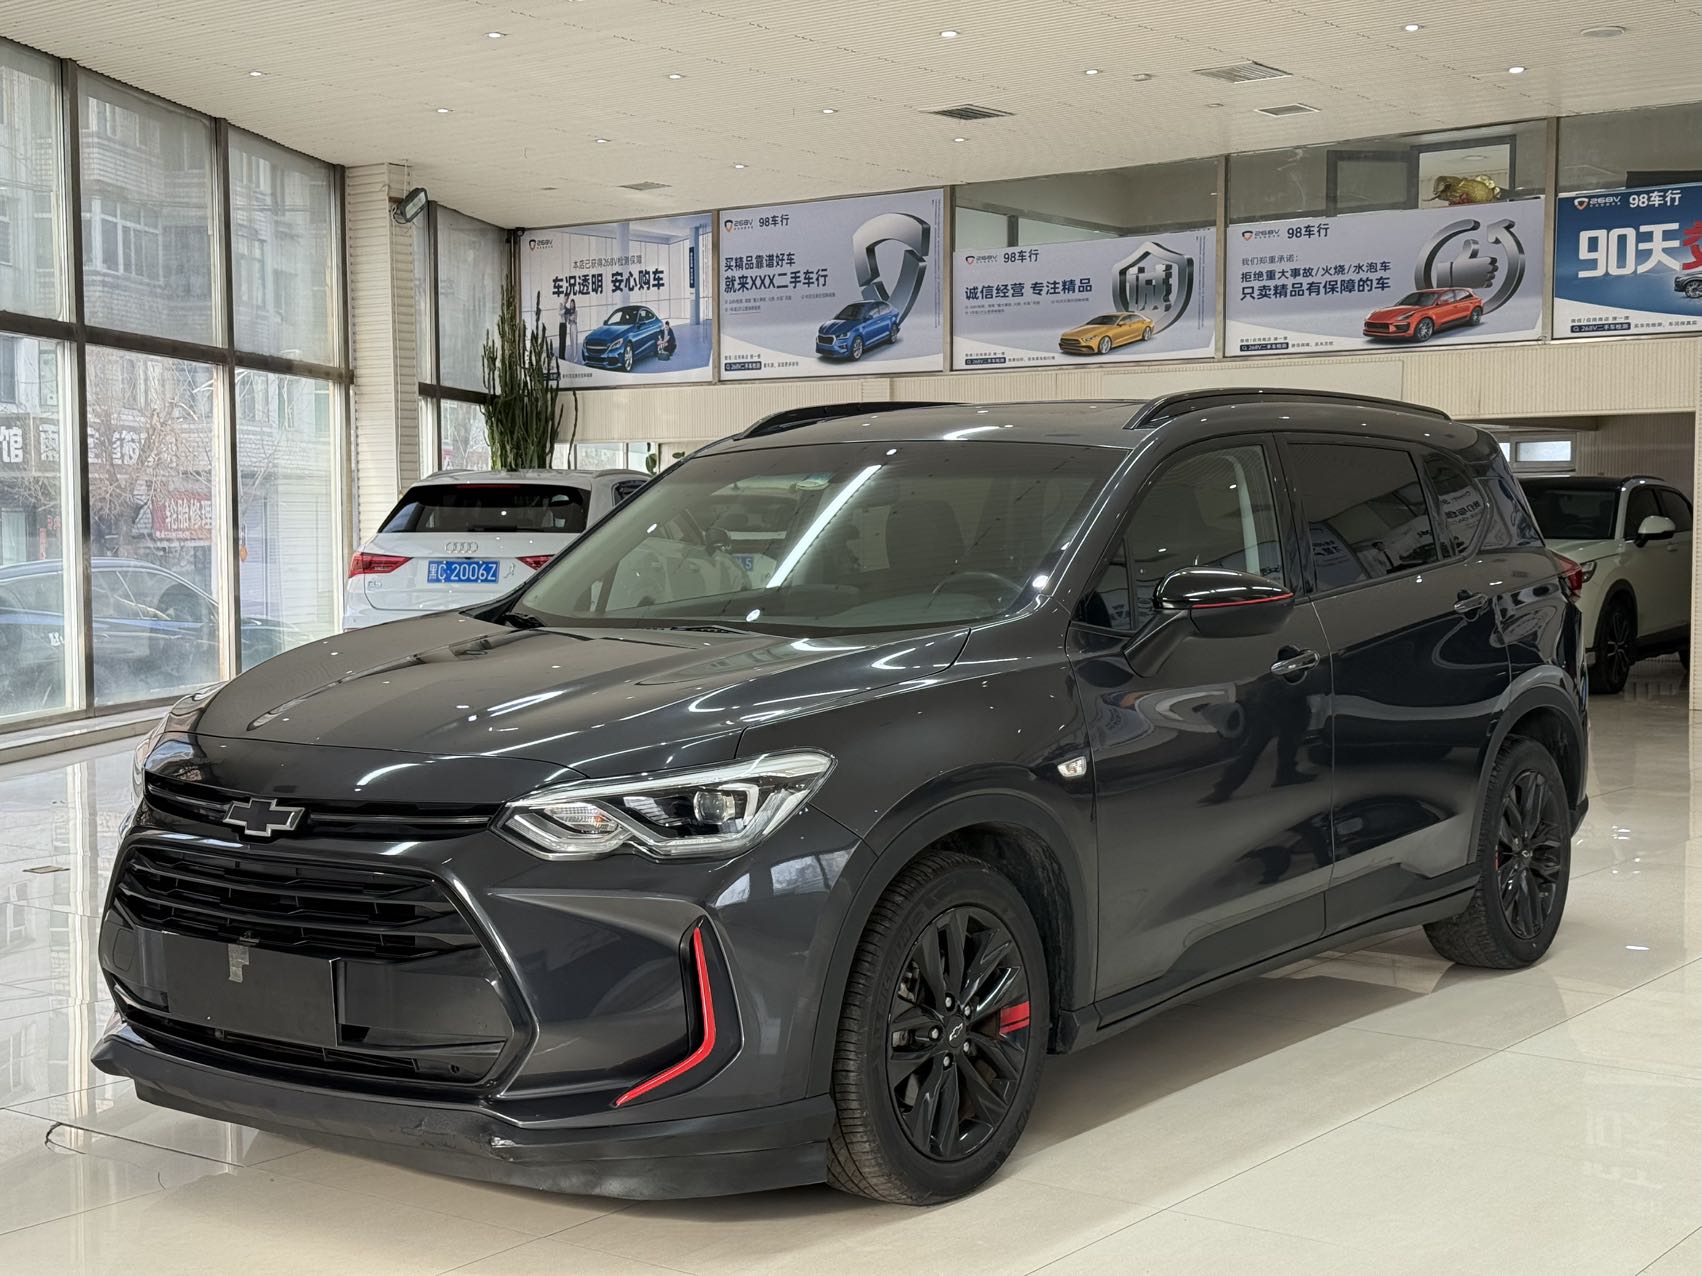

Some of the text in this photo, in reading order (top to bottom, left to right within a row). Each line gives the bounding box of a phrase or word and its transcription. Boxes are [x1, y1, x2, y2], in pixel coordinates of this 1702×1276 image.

[1629, 190, 1682, 208] 98车行
[758, 214, 790, 228] 98车行
[1287, 223, 1330, 239] 98车行
[724, 252, 796, 272] 买精品靠谱好车
[1003, 249, 1040, 263] 98车行
[724, 268, 829, 294] 就来XXX二手车行
[1240, 260, 1392, 283] 拒绝重大事故/火烧/水泡车
[552, 268, 665, 298] 车况透明 安心购车
[965, 277, 1092, 301] 诚信经营 专注精品
[1240, 276, 1391, 301] 只卖精品有保障的车
